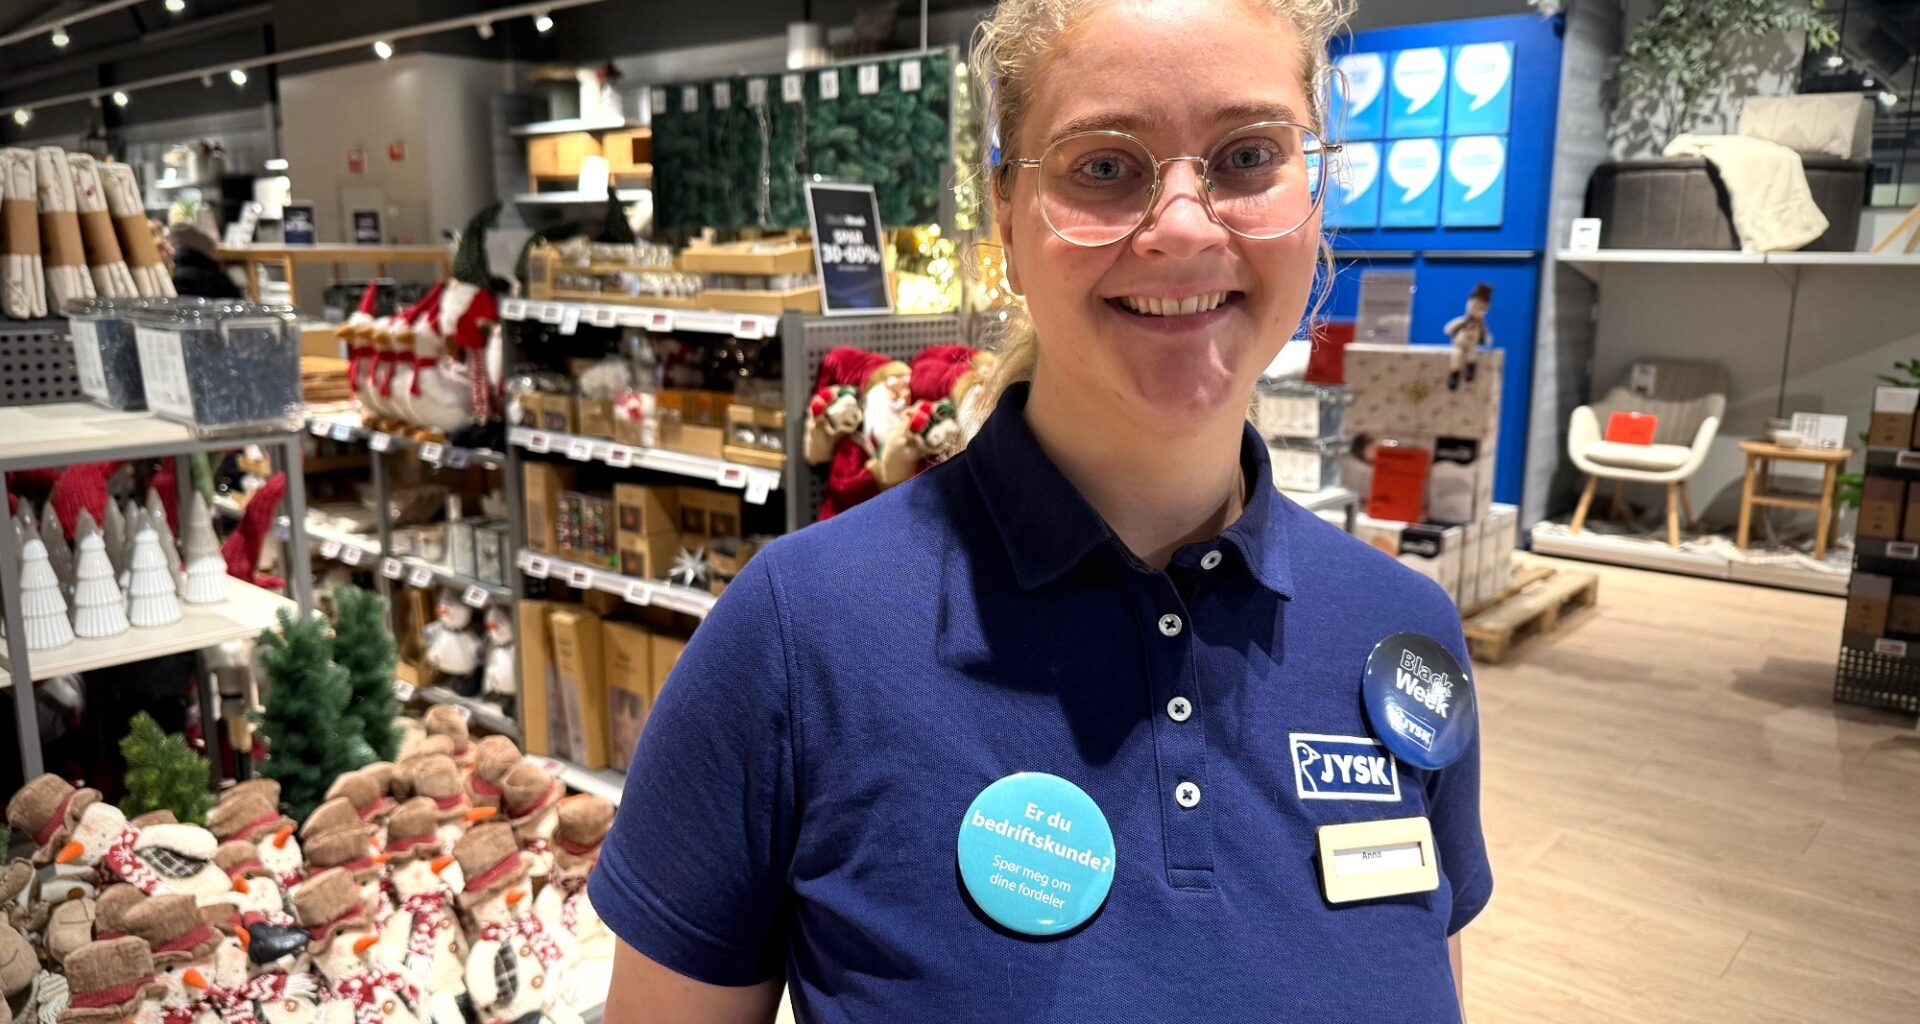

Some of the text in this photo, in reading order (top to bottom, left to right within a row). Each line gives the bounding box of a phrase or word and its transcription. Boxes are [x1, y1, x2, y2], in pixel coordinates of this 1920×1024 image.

[1400, 648, 1453, 691] Black
[1395, 667, 1449, 719] Week
[1403, 718, 1433, 744] JYSK
[1320, 753, 1392, 786] JYSK
[1024, 801, 1072, 832] Er du
[971, 809, 1111, 873] bedriftskunde?
[1362, 851, 1382, 860] Anna
[989, 873, 1066, 909] dine fordeler
[992, 855, 1071, 893] Spør meg om
